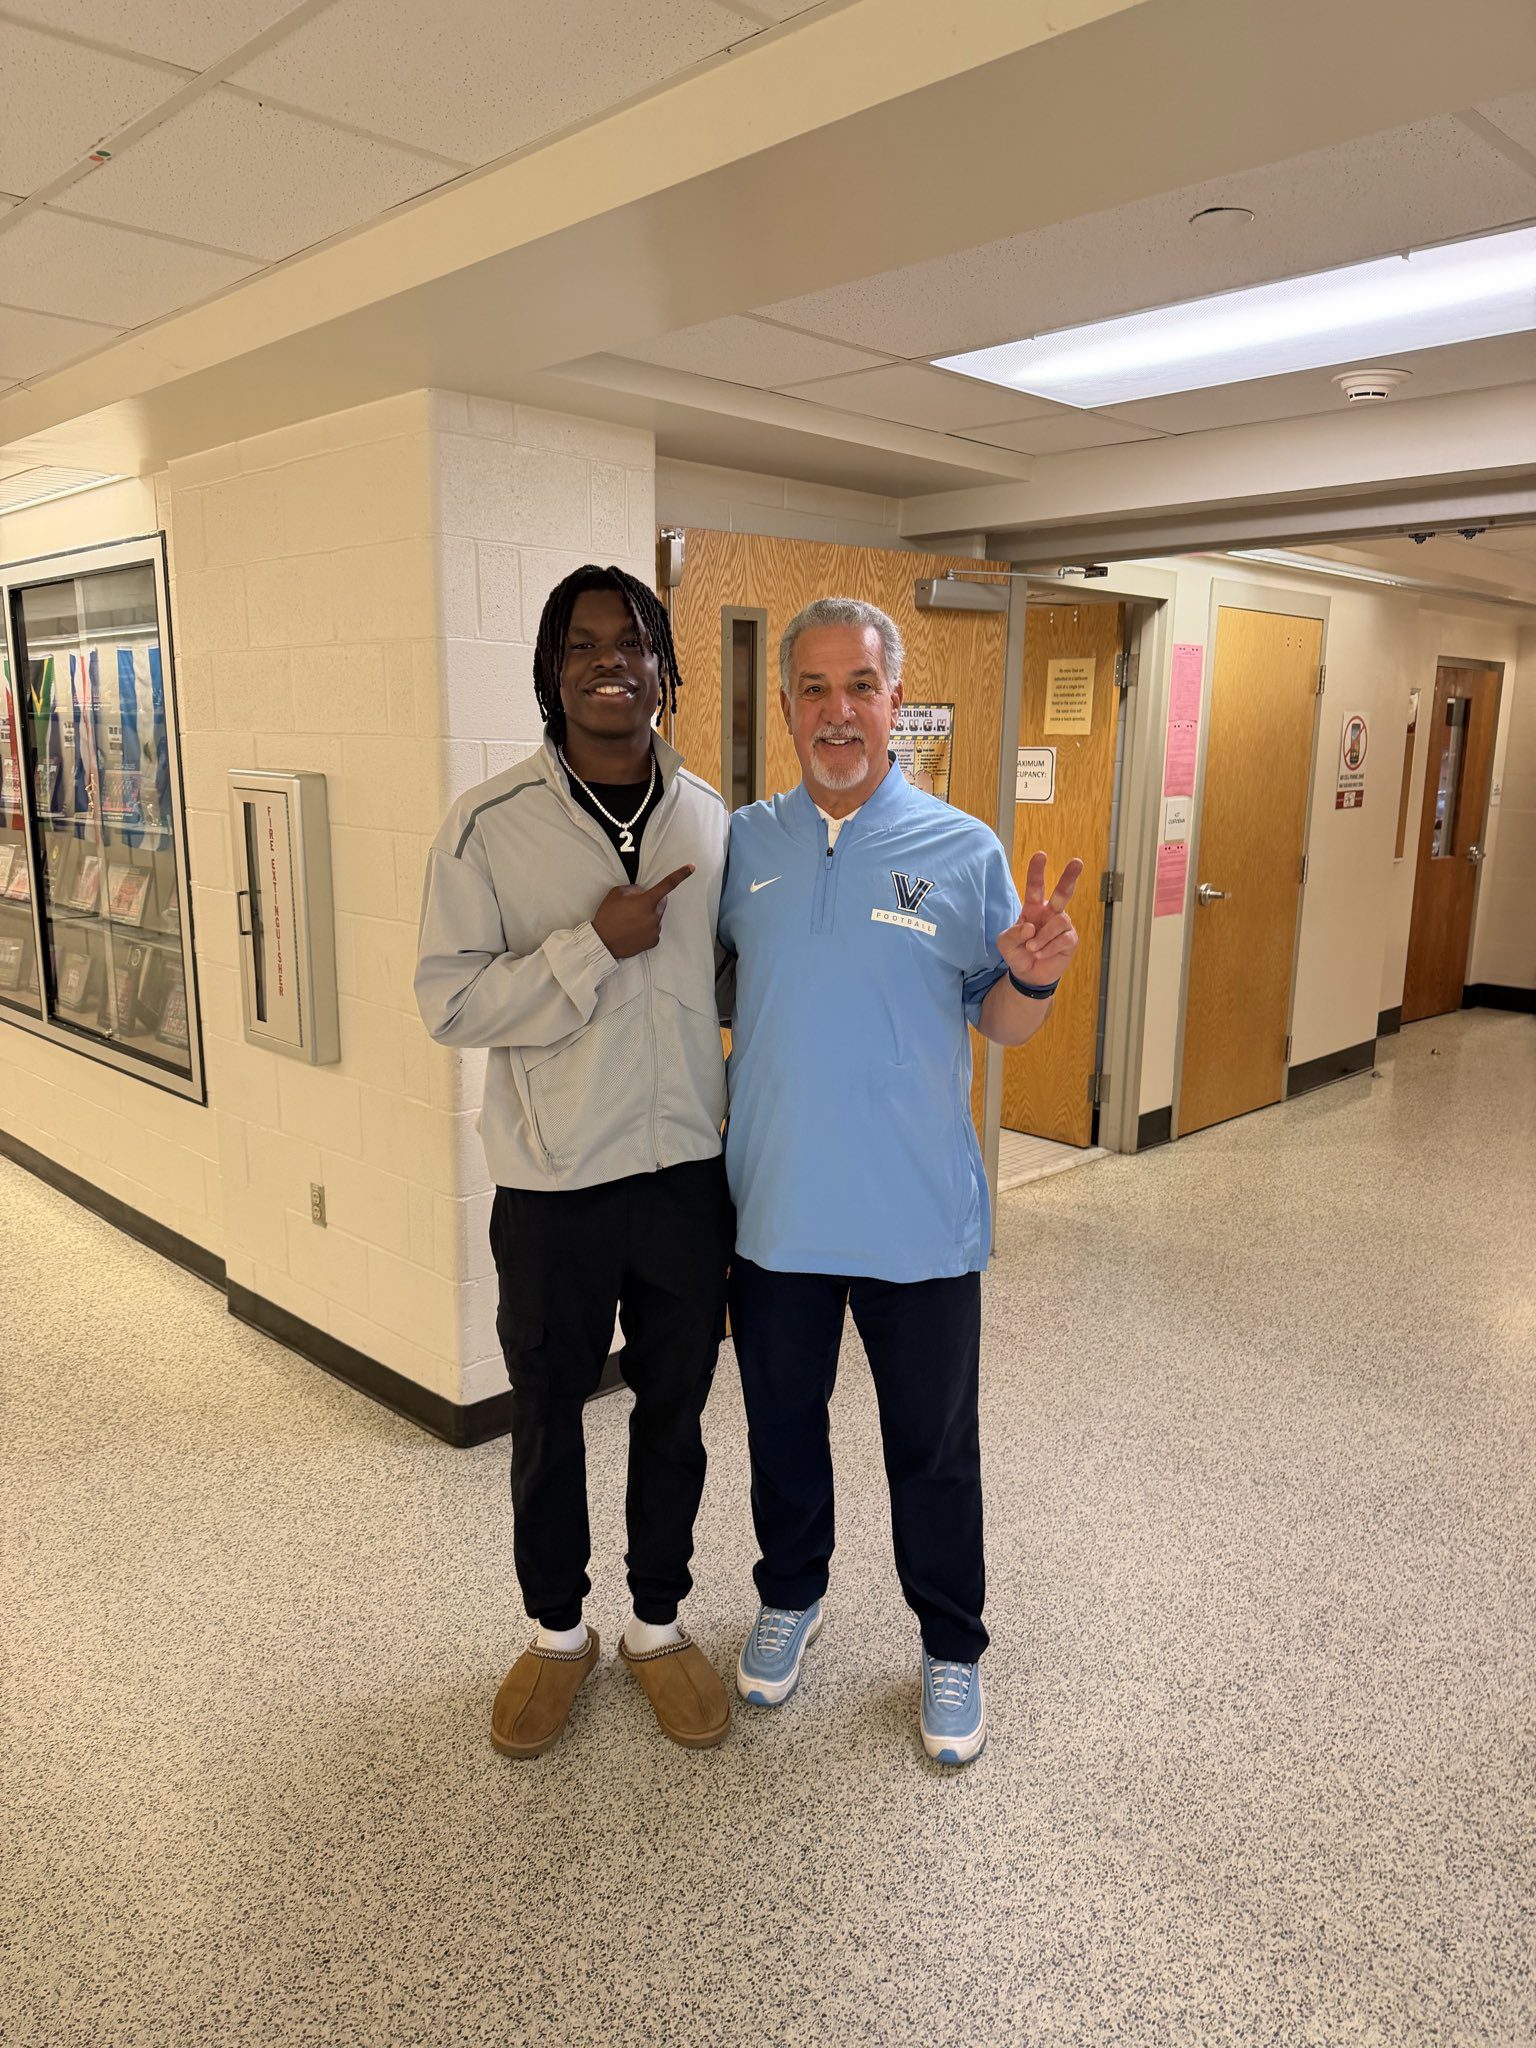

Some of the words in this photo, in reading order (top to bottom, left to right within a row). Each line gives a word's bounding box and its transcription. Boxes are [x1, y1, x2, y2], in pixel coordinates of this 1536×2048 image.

[899, 710, 933, 718] COLONEL
[619, 831, 635, 852] 2
[267, 806, 275, 852] FIRE
[271, 858, 284, 997] EXTINGUISHER
[890, 870, 935, 914] V
[876, 912, 932, 932] FOOTBALL
